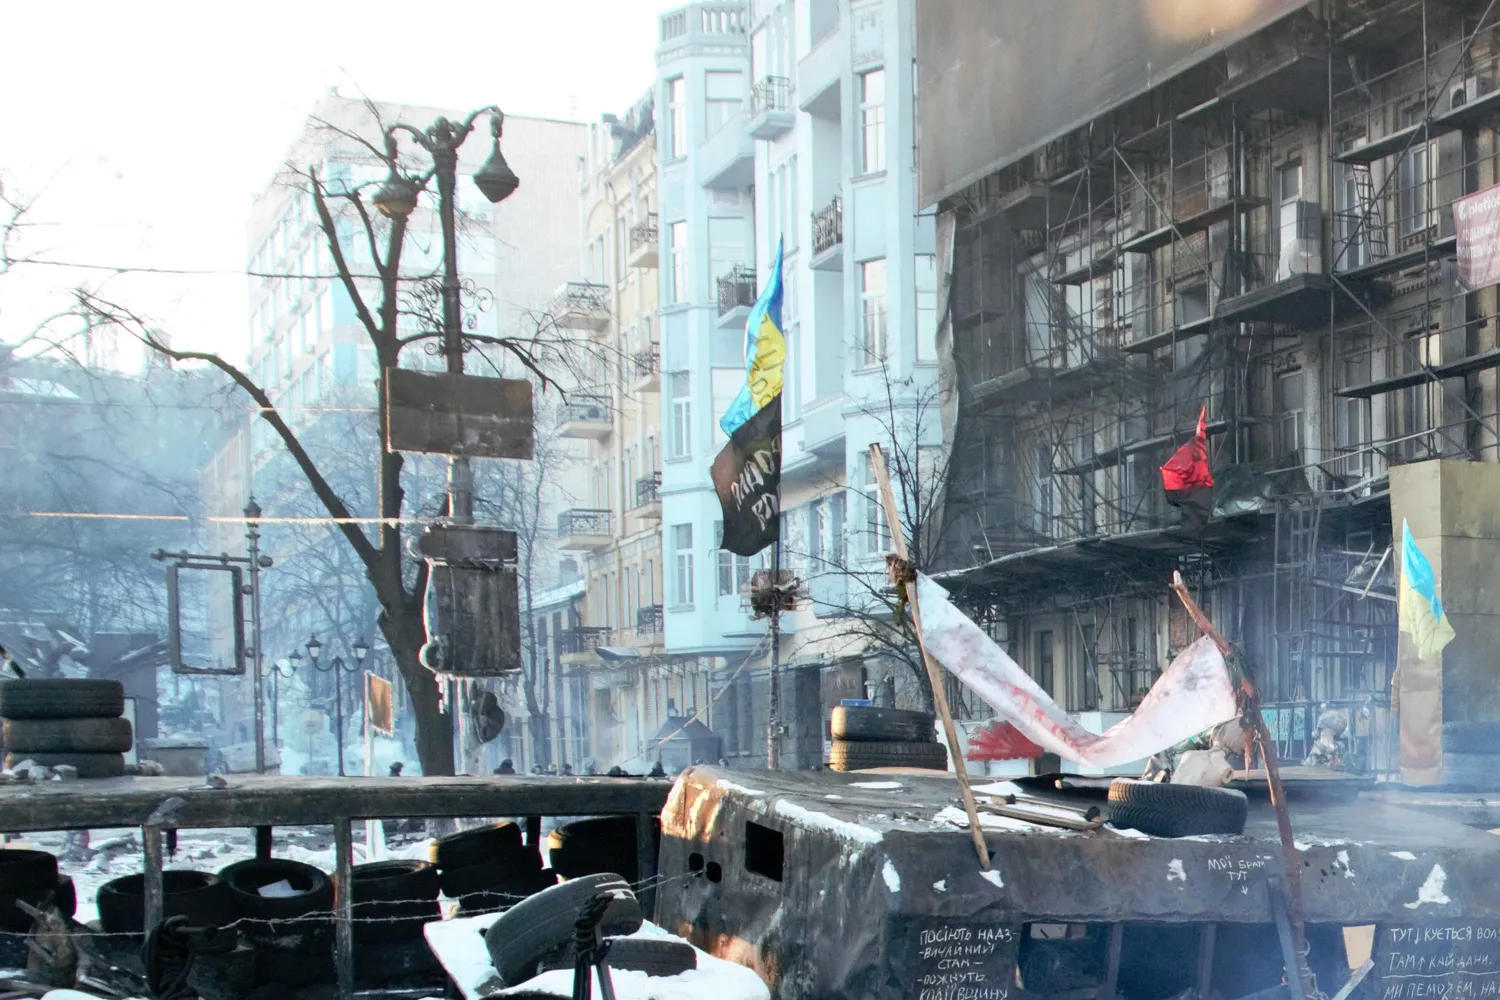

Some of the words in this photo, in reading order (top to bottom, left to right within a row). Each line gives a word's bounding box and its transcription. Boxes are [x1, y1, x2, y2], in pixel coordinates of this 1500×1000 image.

[1390, 927, 1414, 943] ТУТ
[1424, 926, 1473, 942] КУЄТЬСЯ
[1389, 952, 1416, 973] ТАМ
